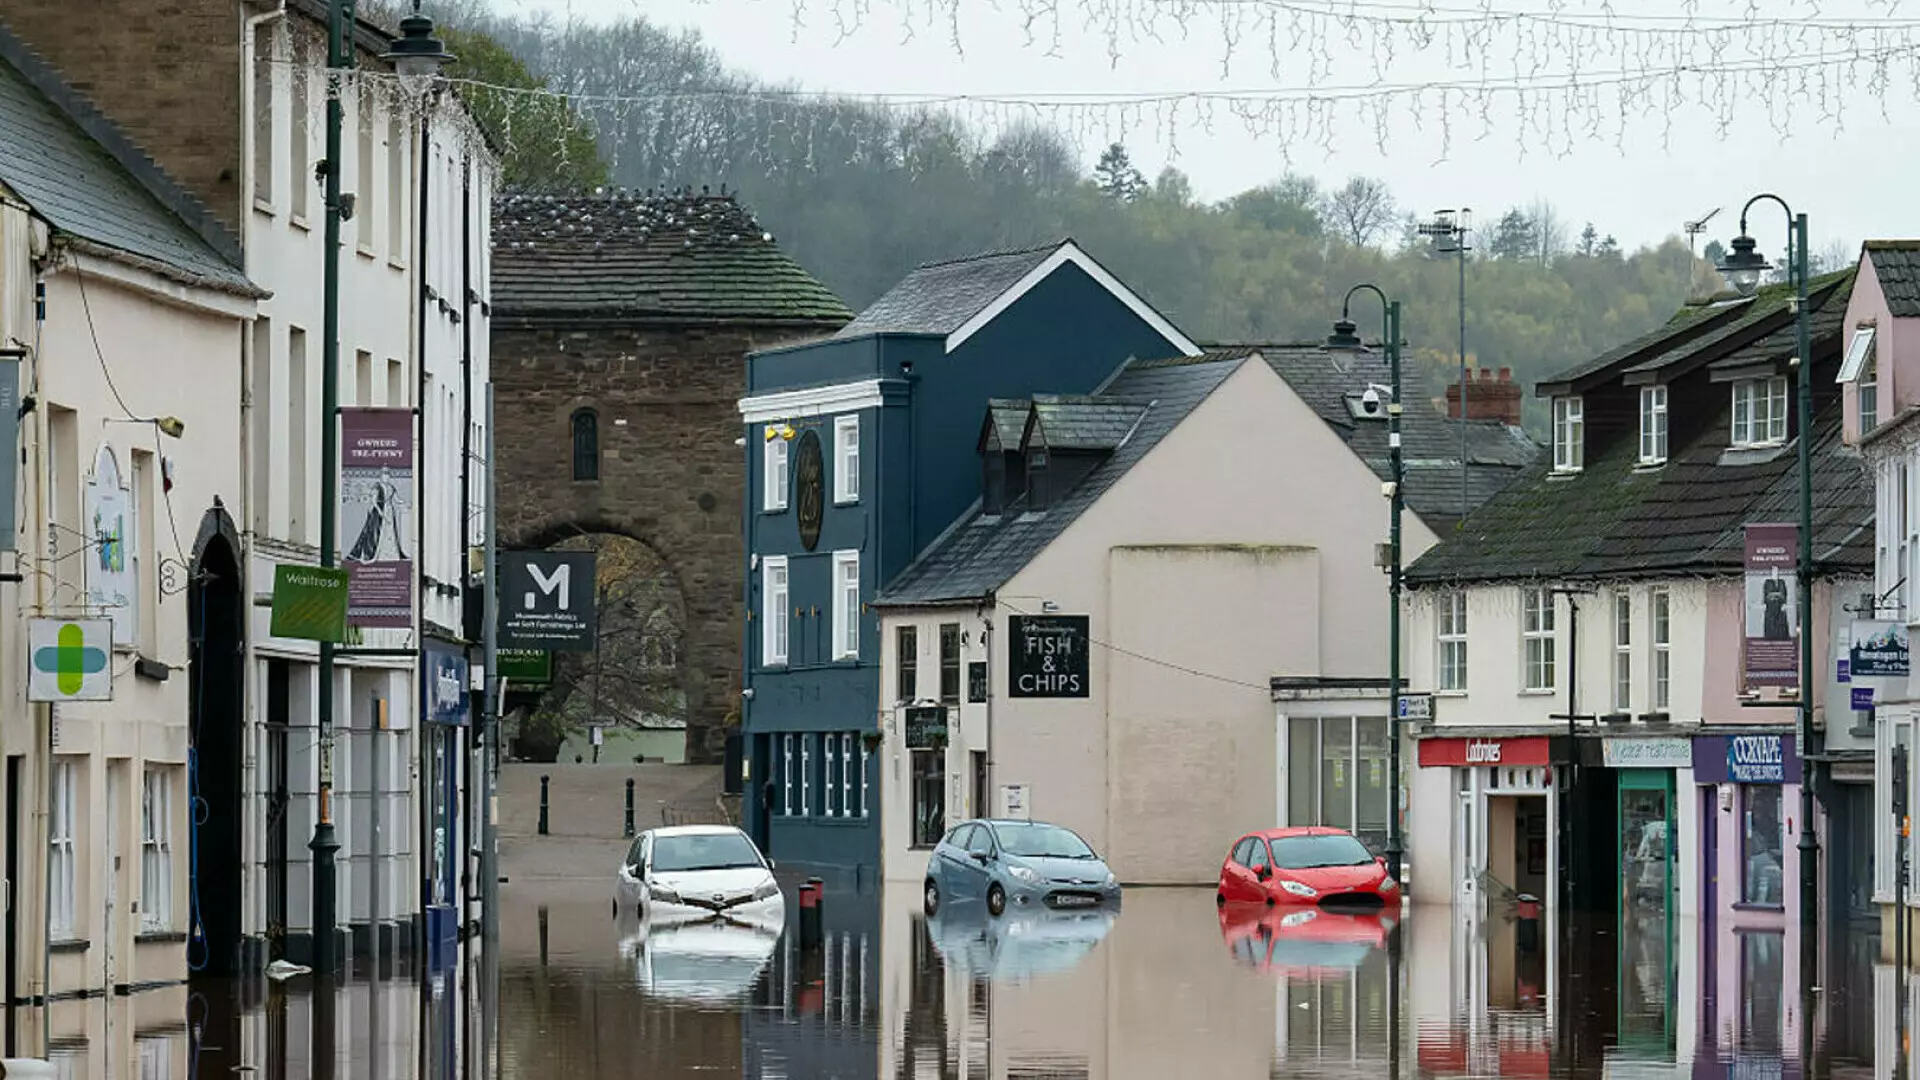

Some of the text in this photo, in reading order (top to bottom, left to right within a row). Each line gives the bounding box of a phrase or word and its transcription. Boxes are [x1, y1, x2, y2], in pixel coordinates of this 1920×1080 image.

[286, 573, 340, 588] Waitrose
[525, 563, 571, 610] M
[1027, 636, 1072, 655] FISH
[1042, 655, 1056, 673] &
[1018, 674, 1081, 693] CHIPS
